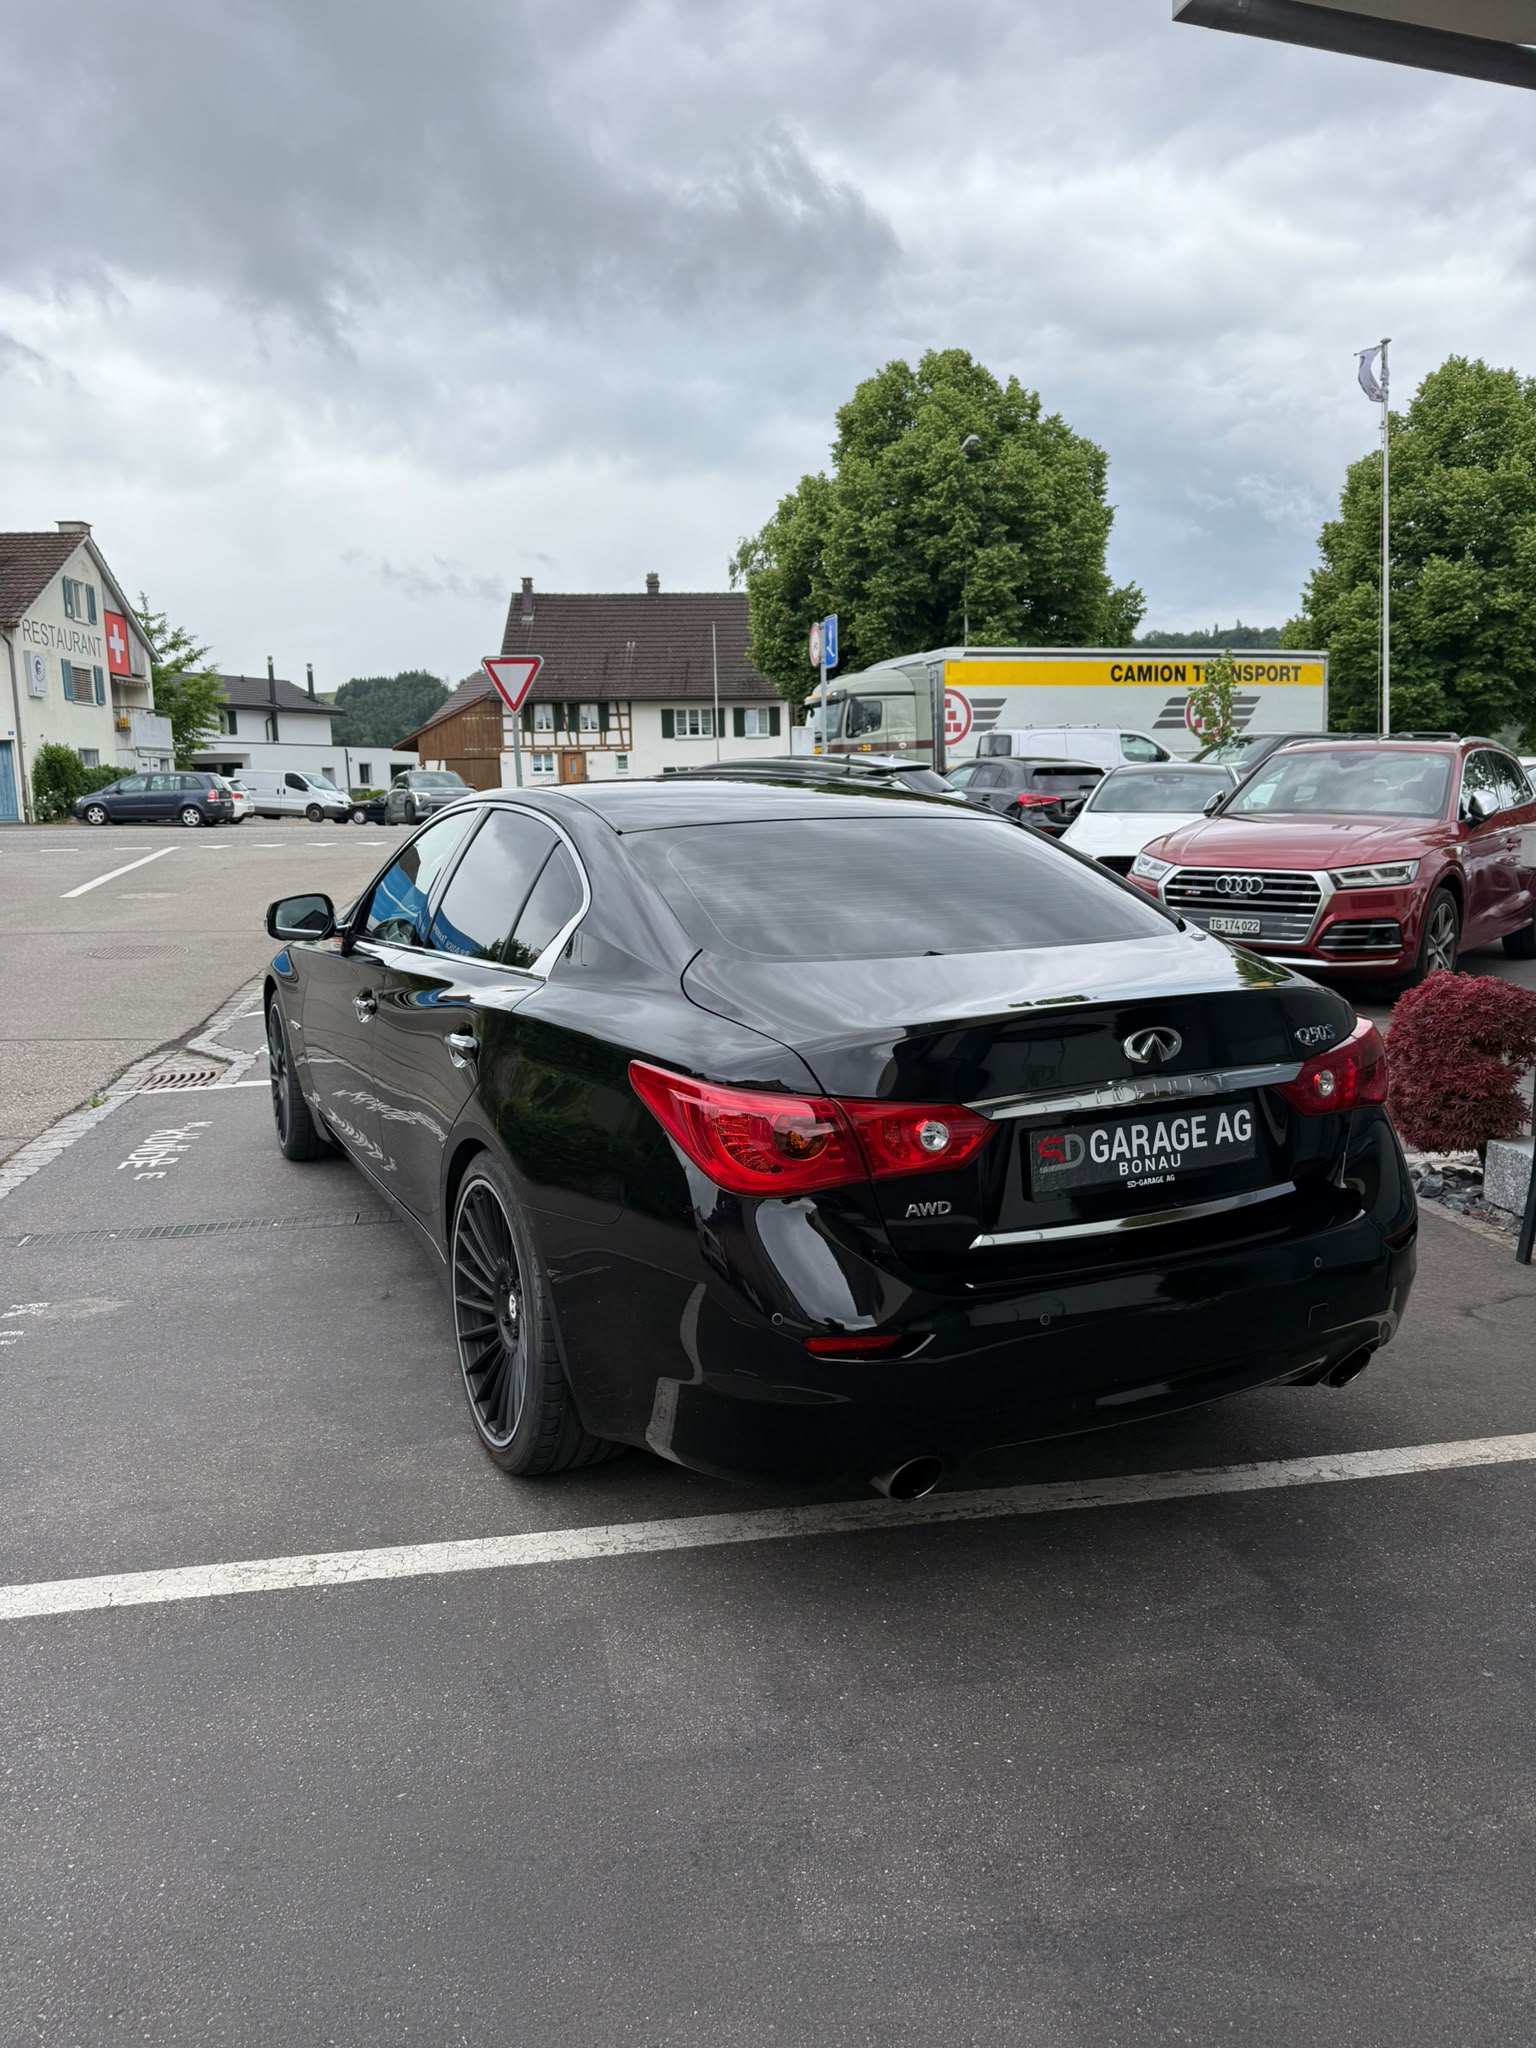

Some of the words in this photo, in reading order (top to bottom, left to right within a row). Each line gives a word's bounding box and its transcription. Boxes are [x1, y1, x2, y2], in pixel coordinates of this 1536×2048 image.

[22, 619, 102, 658] RESTAURANT
[1110, 664, 1187, 683] CAMION
[1193, 665, 1302, 683] TNSPORT
[1089, 1114, 1208, 1164] GARAGE
[1215, 1109, 1253, 1146] AG
[1119, 1153, 1182, 1176] BONAU
[904, 1200, 952, 1218] AWD
